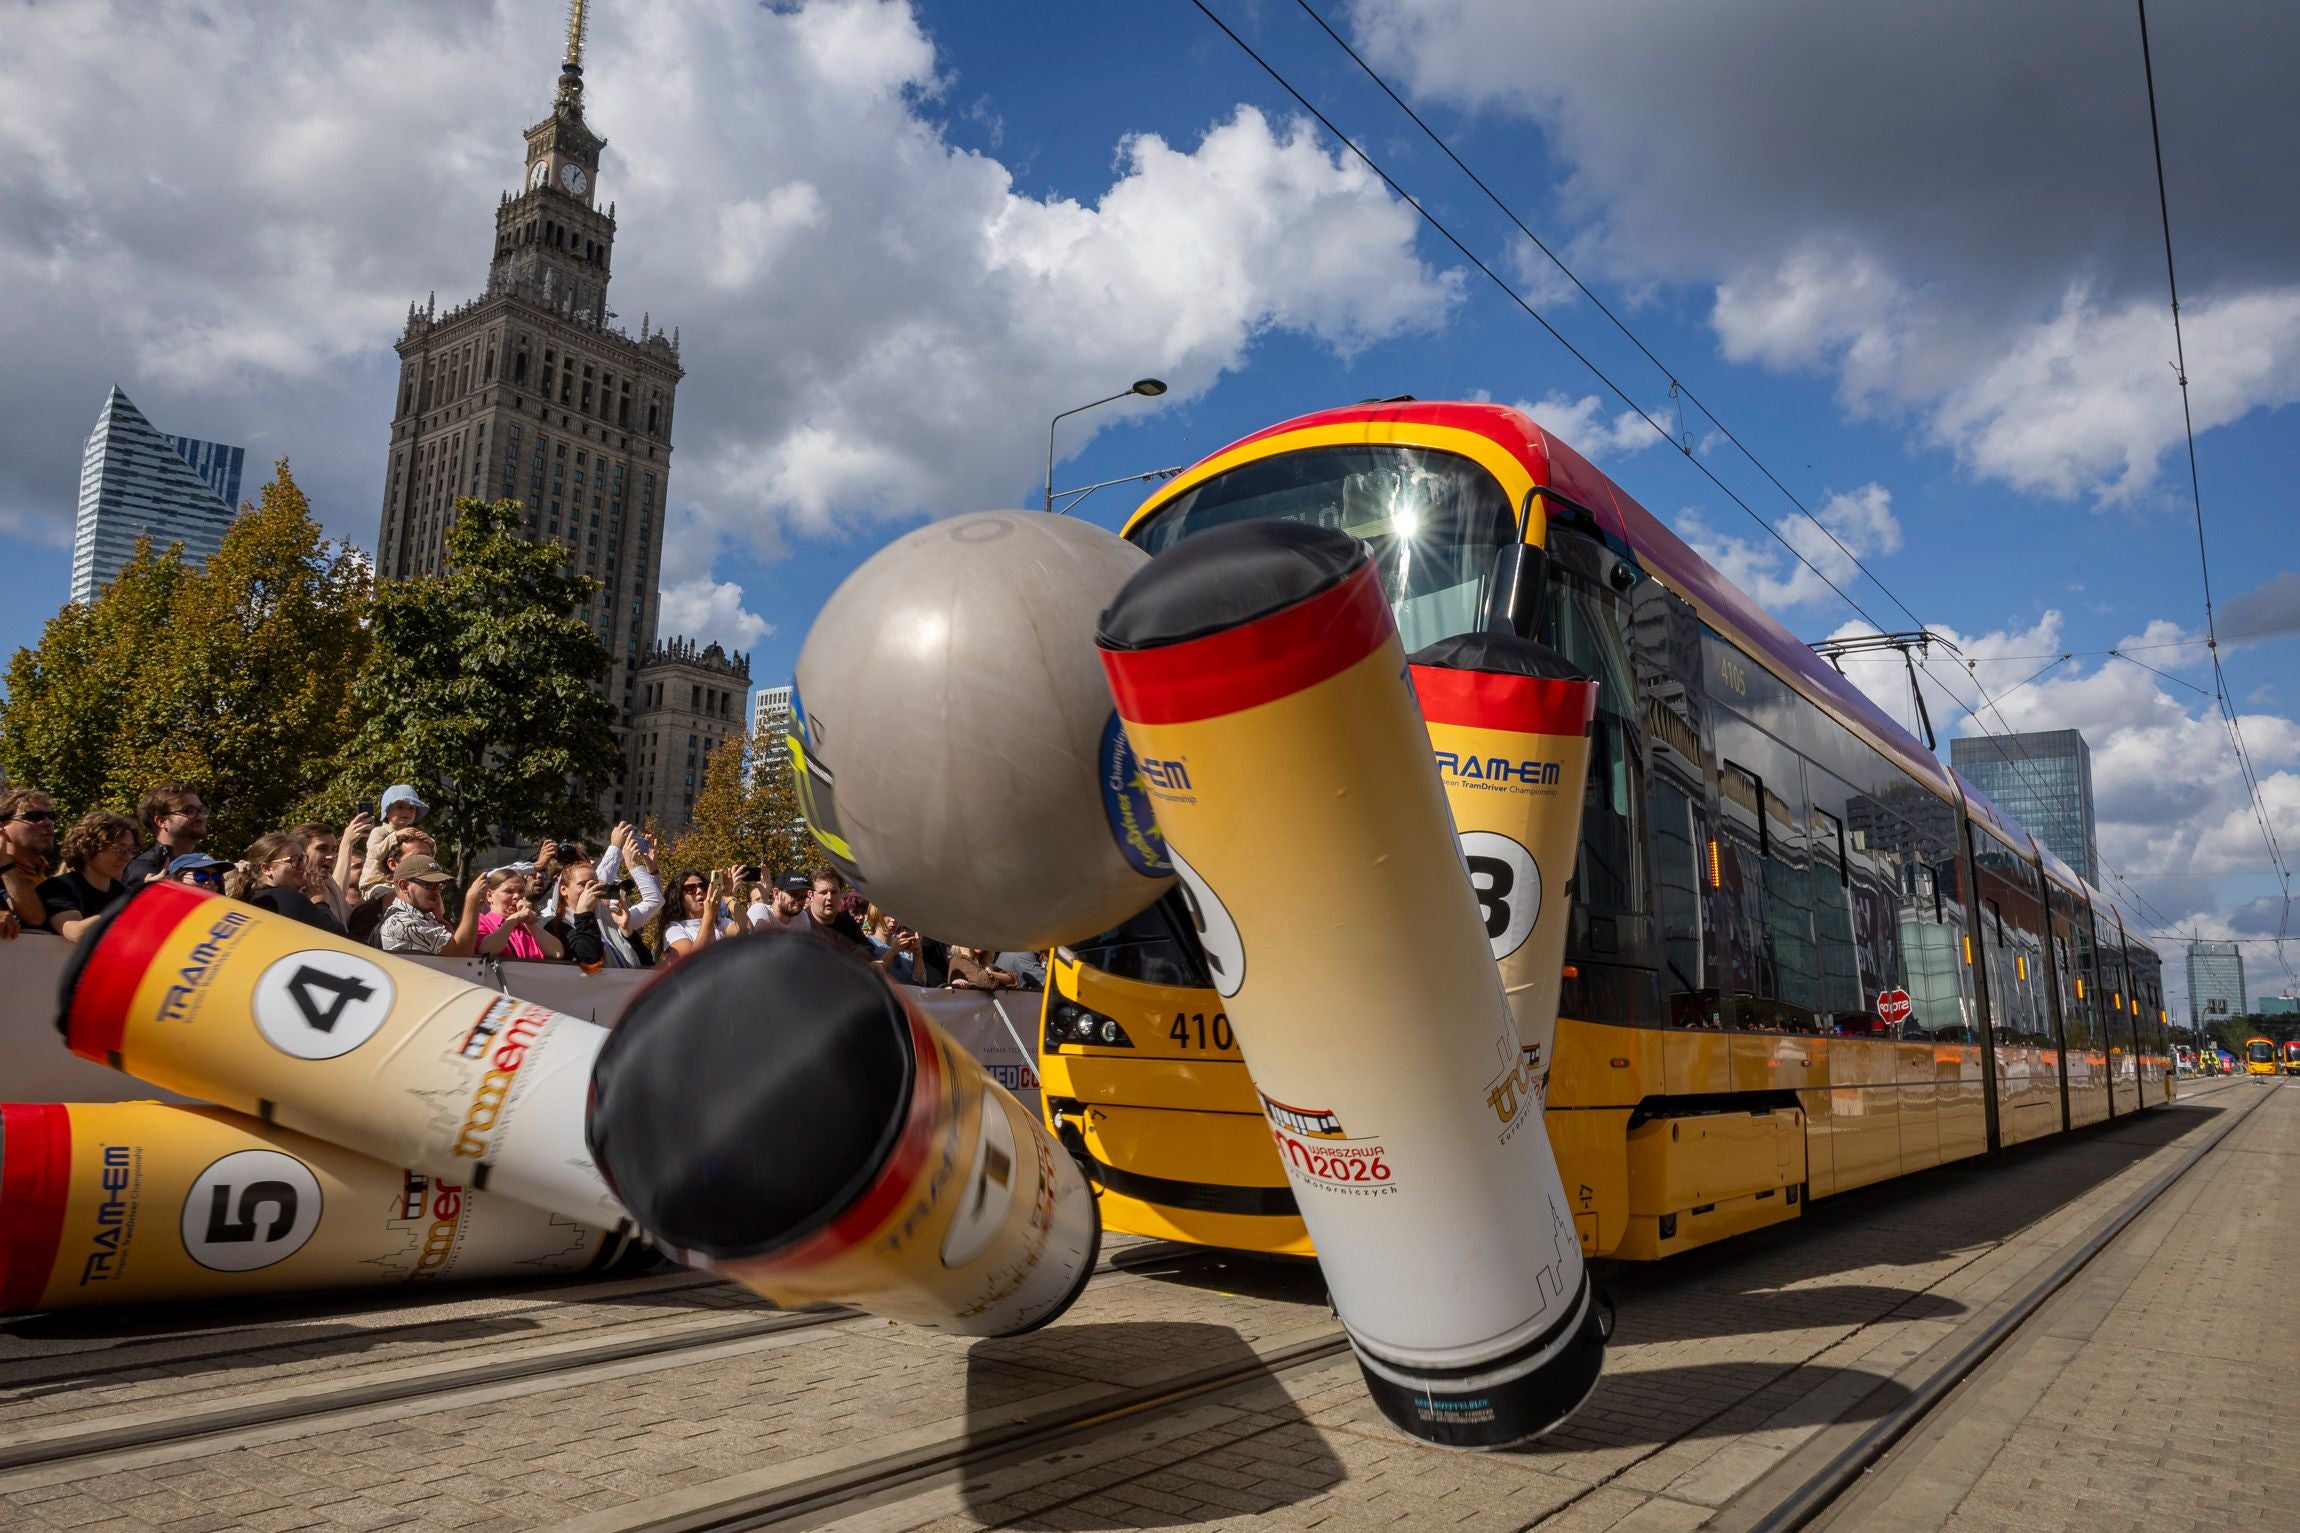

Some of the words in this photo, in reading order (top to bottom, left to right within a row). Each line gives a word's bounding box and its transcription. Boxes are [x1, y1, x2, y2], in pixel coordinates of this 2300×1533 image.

[1721, 657, 1746, 697] 4105
[1435, 750, 1560, 785] RAM-EM
[1461, 780, 1508, 793] TramDriver
[156, 911, 252, 1022] TRAM-EM
[286, 964, 377, 1034] 4
[1169, 1011, 1241, 1051] 410
[1308, 1144, 1386, 1158] WARSZAWA
[1313, 1156, 1392, 1182] 2026
[130, 1146, 144, 1199] Championship
[1303, 1176, 1398, 1197] Motorniczych
[79, 1146, 129, 1287] TRAM-EM
[204, 1180, 299, 1244] 5
